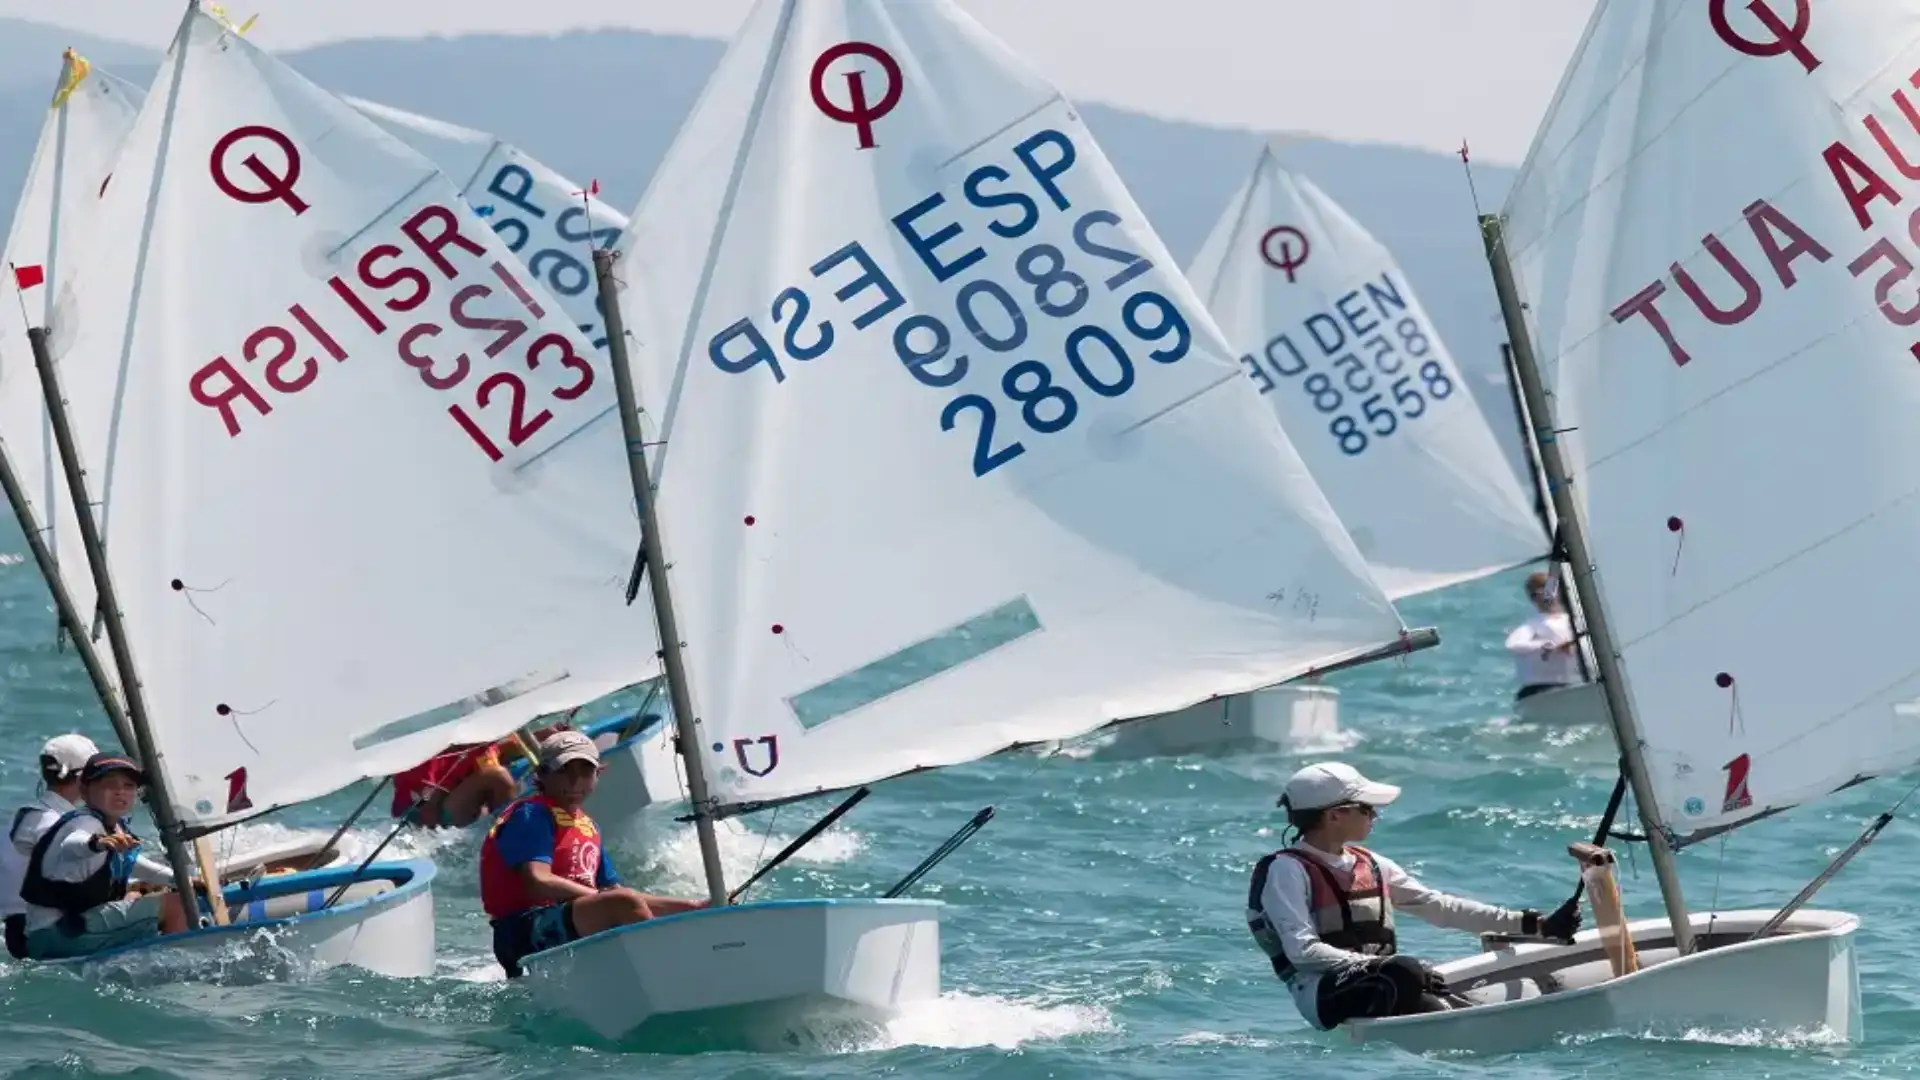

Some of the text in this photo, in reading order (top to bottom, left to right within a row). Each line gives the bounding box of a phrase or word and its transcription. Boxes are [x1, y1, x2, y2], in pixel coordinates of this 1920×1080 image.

[891, 129, 1076, 282] ESP
[1821, 66, 1920, 231] AU
[328, 205, 487, 335] ISR
[1303, 272, 1406, 356] DEN
[448, 333, 594, 462] 123
[940, 291, 1192, 478] 2809
[1329, 360, 1452, 456] 8558
